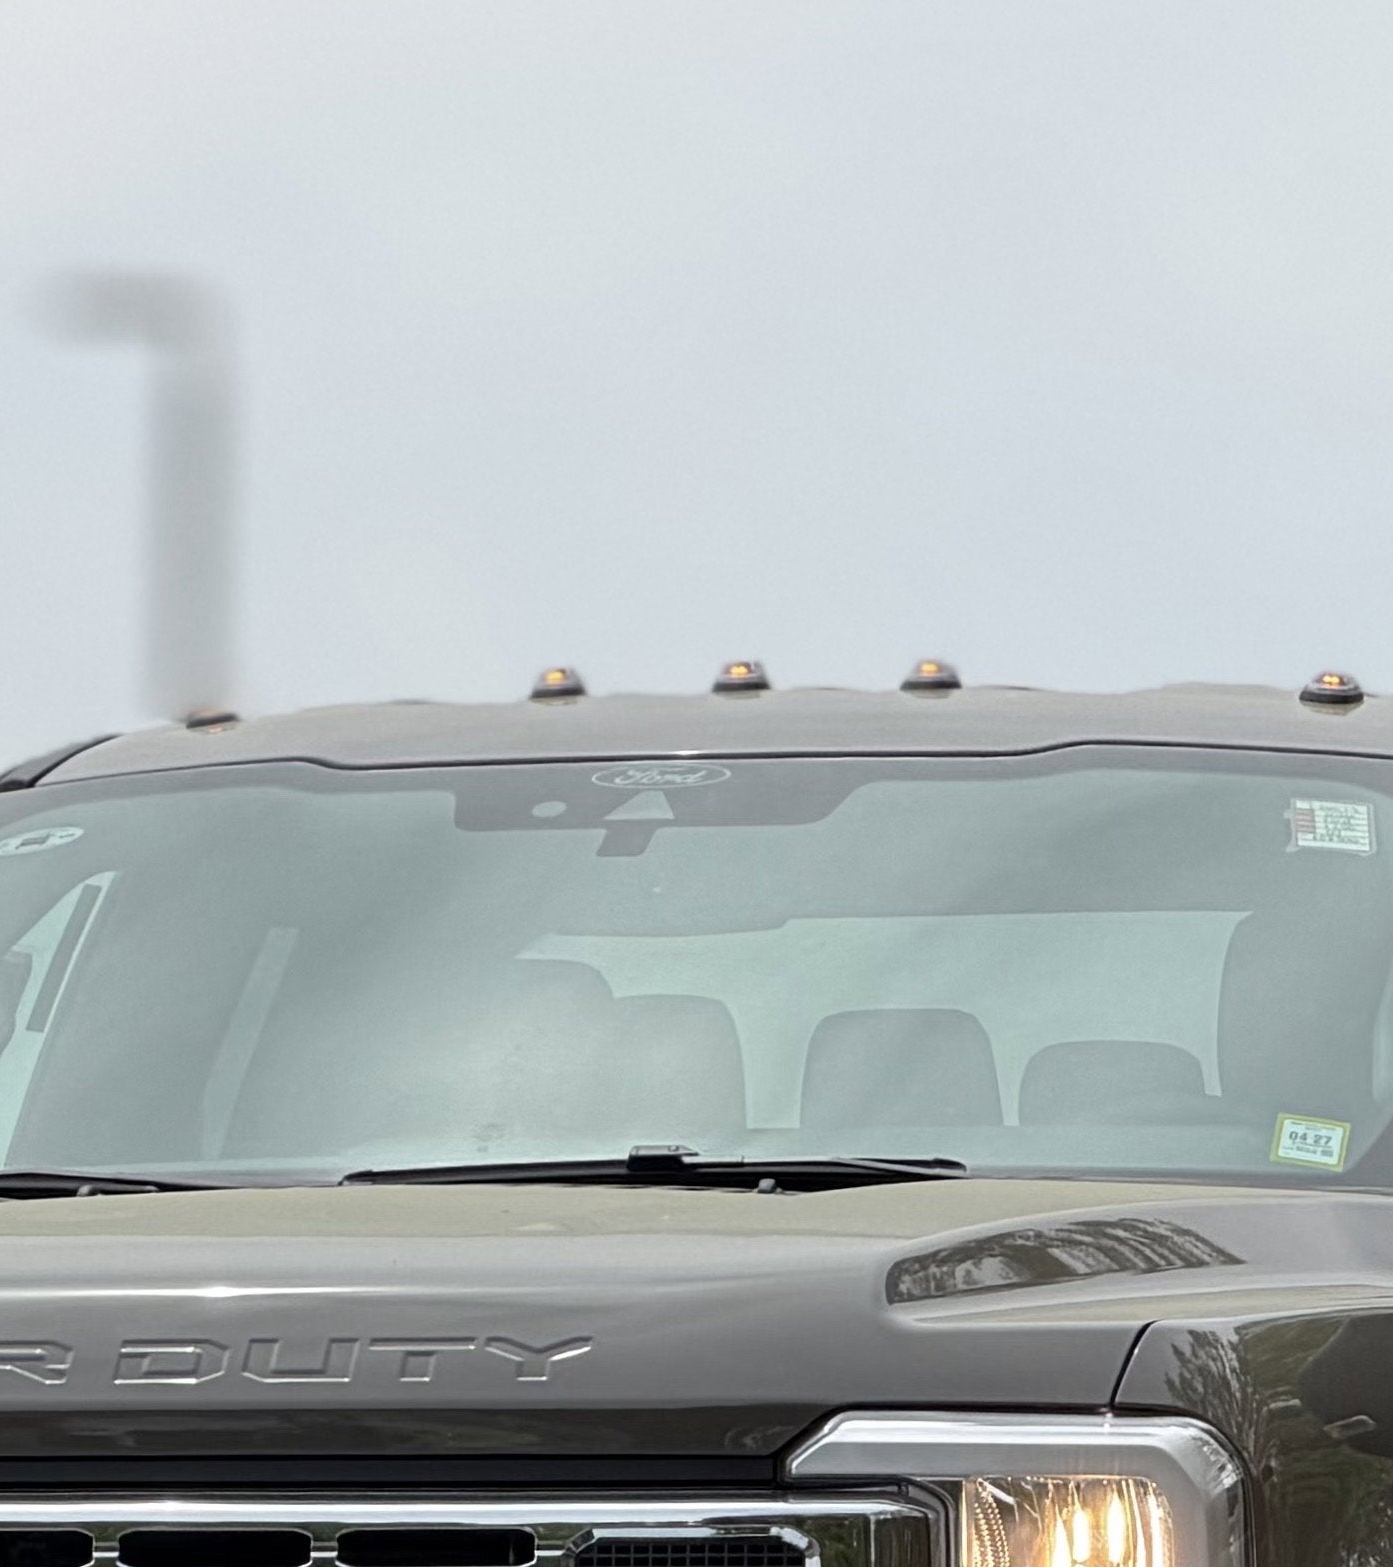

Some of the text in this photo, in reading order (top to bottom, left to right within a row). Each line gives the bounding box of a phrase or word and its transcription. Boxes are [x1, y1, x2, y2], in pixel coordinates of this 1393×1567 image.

[614, 767, 707, 784] Ford
[1289, 1131, 1308, 1142] 04
[113, 1336, 594, 1384] DUTY
